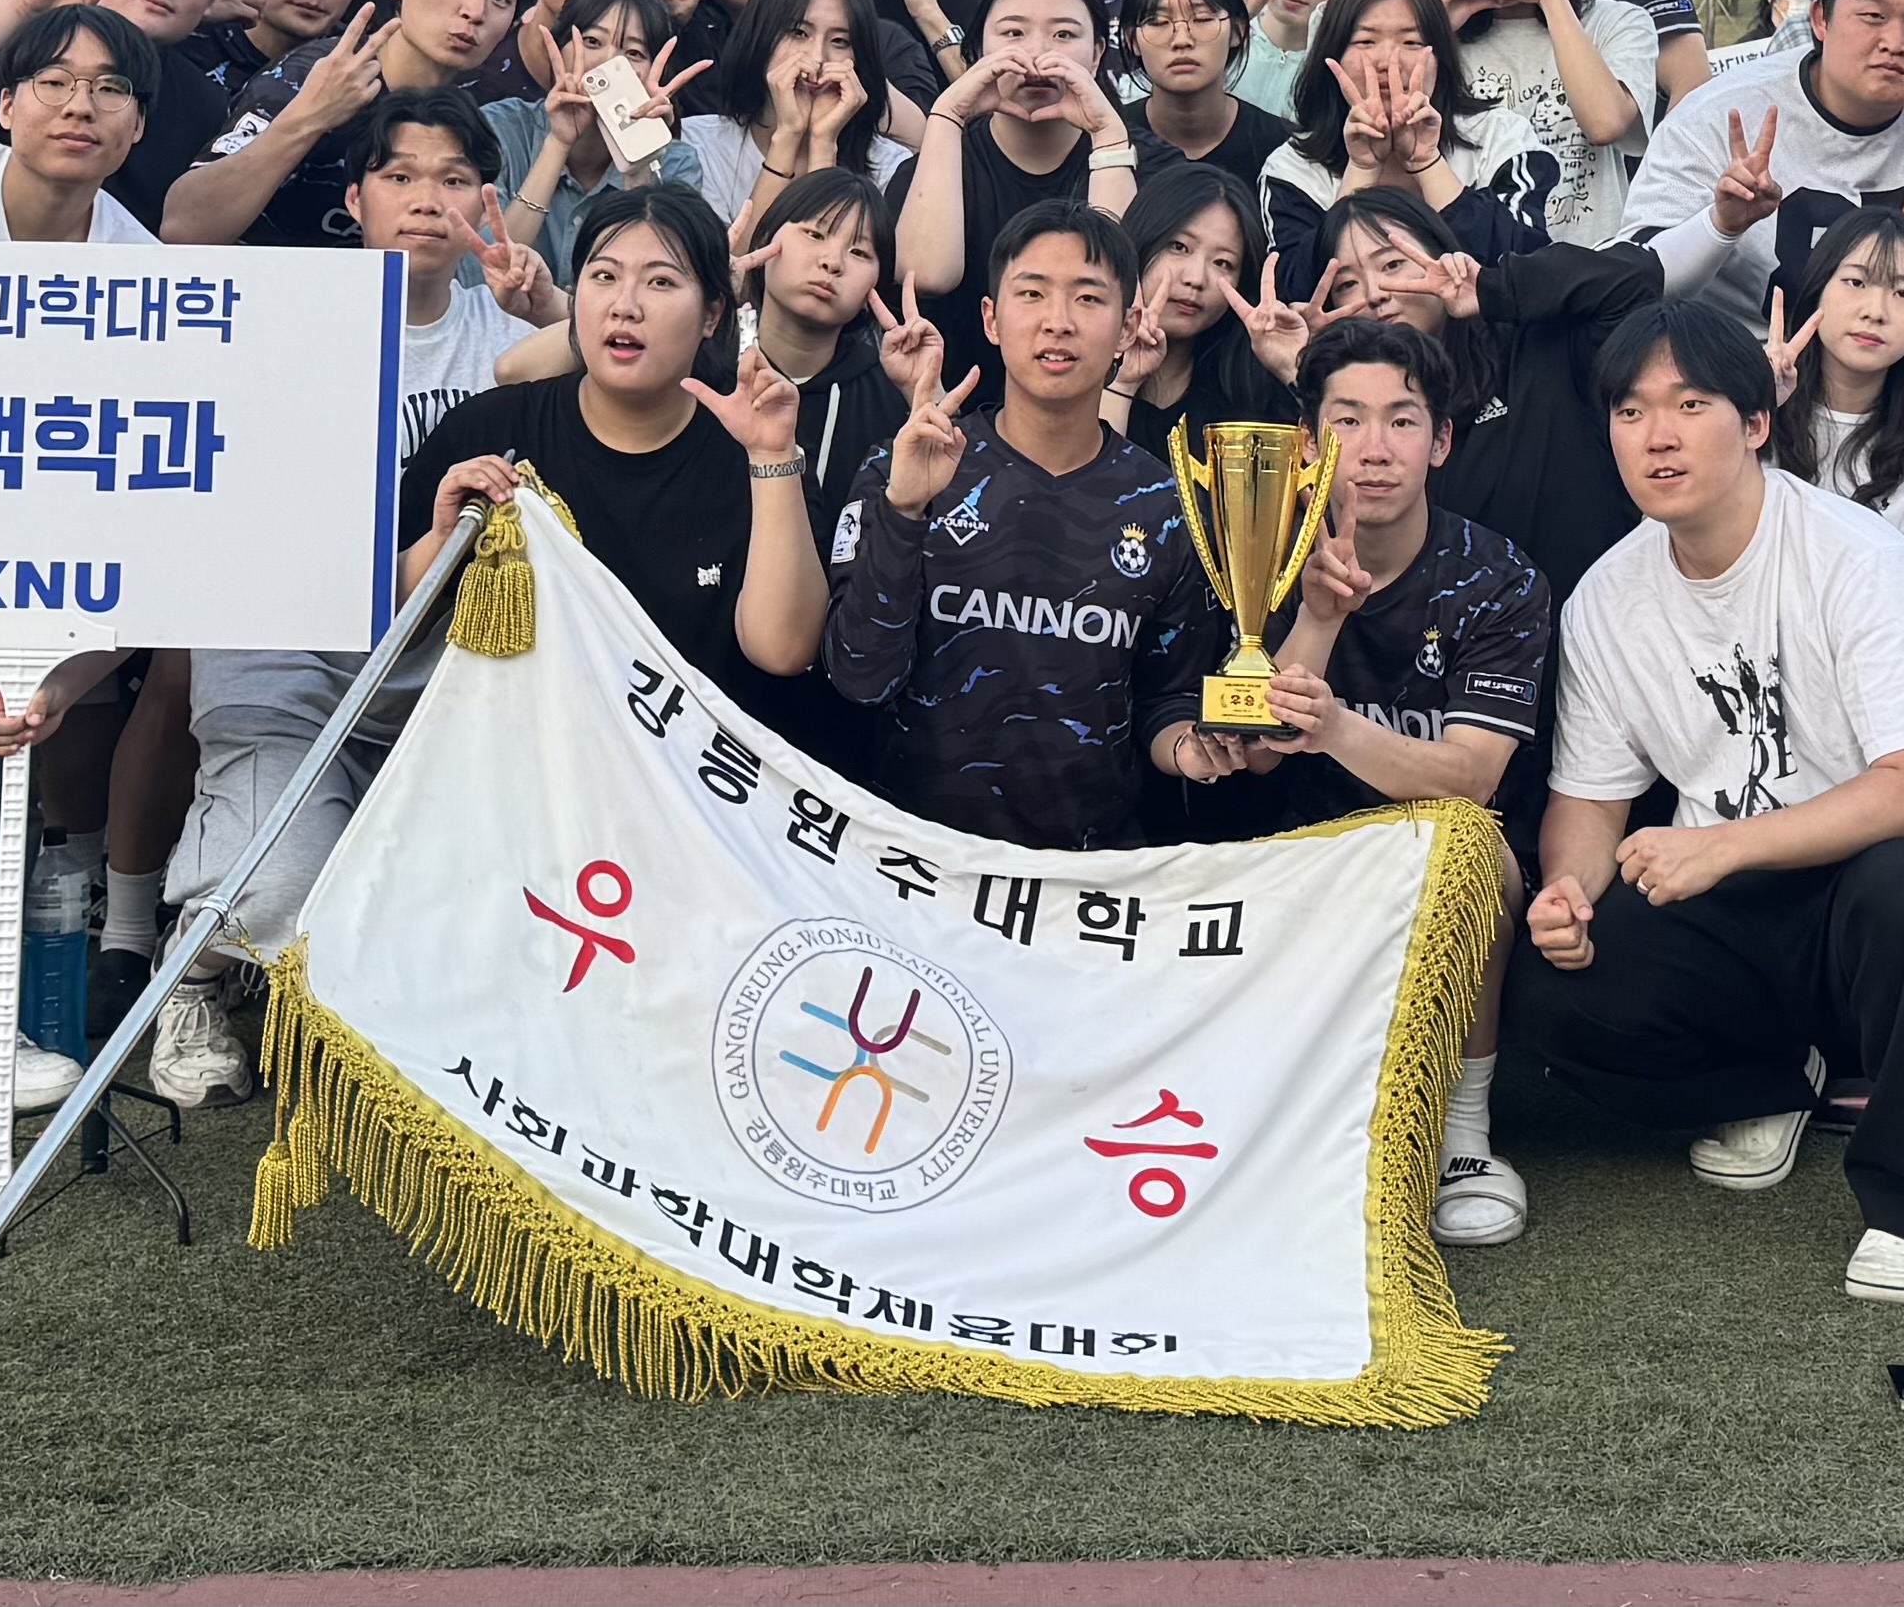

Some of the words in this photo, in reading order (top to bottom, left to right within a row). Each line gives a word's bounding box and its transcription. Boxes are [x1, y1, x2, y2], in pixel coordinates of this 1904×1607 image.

[930, 584, 1142, 649] CANNON
[627, 659, 1245, 961] 강릉원주대학교
[523, 860, 636, 993] 우
[1084, 1088, 1218, 1218] 승
[725, 927, 881, 1100] GANGNEUNG-WONJU
[917, 1047, 1000, 1187] UNIVERSITY
[746, 1116, 900, 1203] 강릉원주대학교
[1447, 1157, 1492, 1174] NIKE
